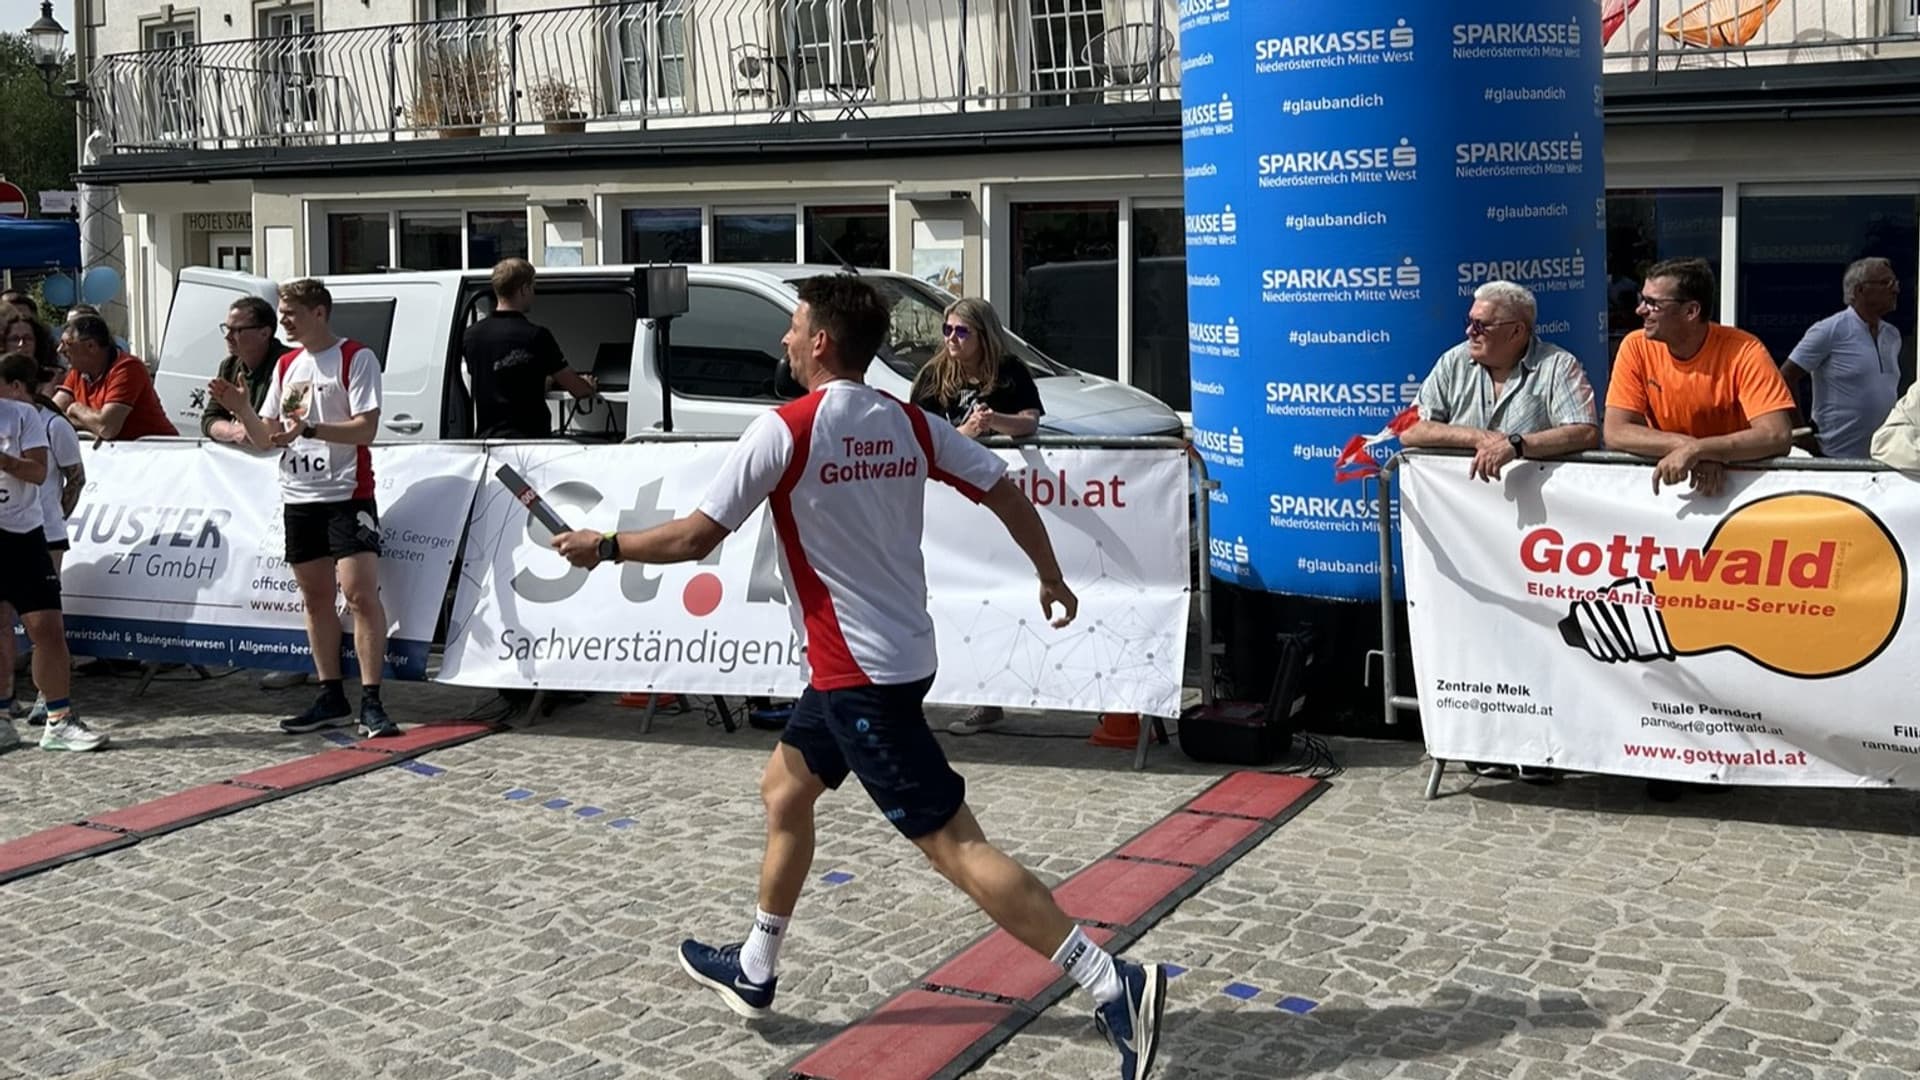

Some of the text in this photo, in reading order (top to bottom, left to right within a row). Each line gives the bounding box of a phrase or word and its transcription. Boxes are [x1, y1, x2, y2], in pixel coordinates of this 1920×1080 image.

[1255, 29, 1385, 60] SPARKASSE
[1453, 23, 1565, 45] SPARKASSE
[1256, 51, 1414, 74] Niederösterreich Mitte West
[1453, 47, 1541, 59] Niederösterreich
[1282, 93, 1384, 116] #glaubandich
[1484, 86, 1566, 103] #glaubandich
[1258, 148, 1388, 175] SPARKASSE
[1456, 141, 1568, 164] SPARKASSE
[1259, 170, 1417, 188] Niederösterreich Mitte West
[1456, 164, 1543, 178] Niederösterreich
[190, 213, 222, 230] HOTEL
[1285, 211, 1387, 231] #glaubandich
[1486, 203, 1568, 221] #glaubandich
[1262, 267, 1392, 289] SPARKASSE
[1458, 258, 1570, 283] SPARKASSE
[1262, 288, 1421, 303] Niederösterreich Mitte West
[1289, 329, 1390, 347] #glaubandich
[1266, 382, 1396, 404] SPARKASSE
[1266, 403, 1356, 417] Niederösterreich
[1358, 405, 1390, 417] Mitte
[842, 436, 893, 457] Team
[289, 454, 325, 474] 11c
[819, 456, 918, 485] Gottwald
[66, 503, 232, 549] HUSTER
[1270, 515, 1359, 532] Niederösterreich
[402, 530, 455, 550] Georgen
[108, 552, 216, 579] ZT GmbH
[1519, 527, 1838, 589] Gottwald
[1527, 581, 1836, 617] Elektro-Anlagenbau-Service
[66, 629, 120, 642] erwirtschaft
[136, 632, 225, 650] Bauingenieurwesen
[238, 640, 289, 655] Allgemein
[499, 628, 801, 673] Sachverständigenb
[1436, 680, 1531, 697] Zentrale Melk
[1436, 697, 1553, 717] office@gottwald.at
[1651, 702, 1762, 720] Filiale Parndorf
[1640, 715, 1784, 736] parndorf@gottwald.at
[1893, 725, 1920, 738] Fili
[1624, 741, 1807, 766] www.gottwald.at
[1862, 741, 1920, 754] ramsau
